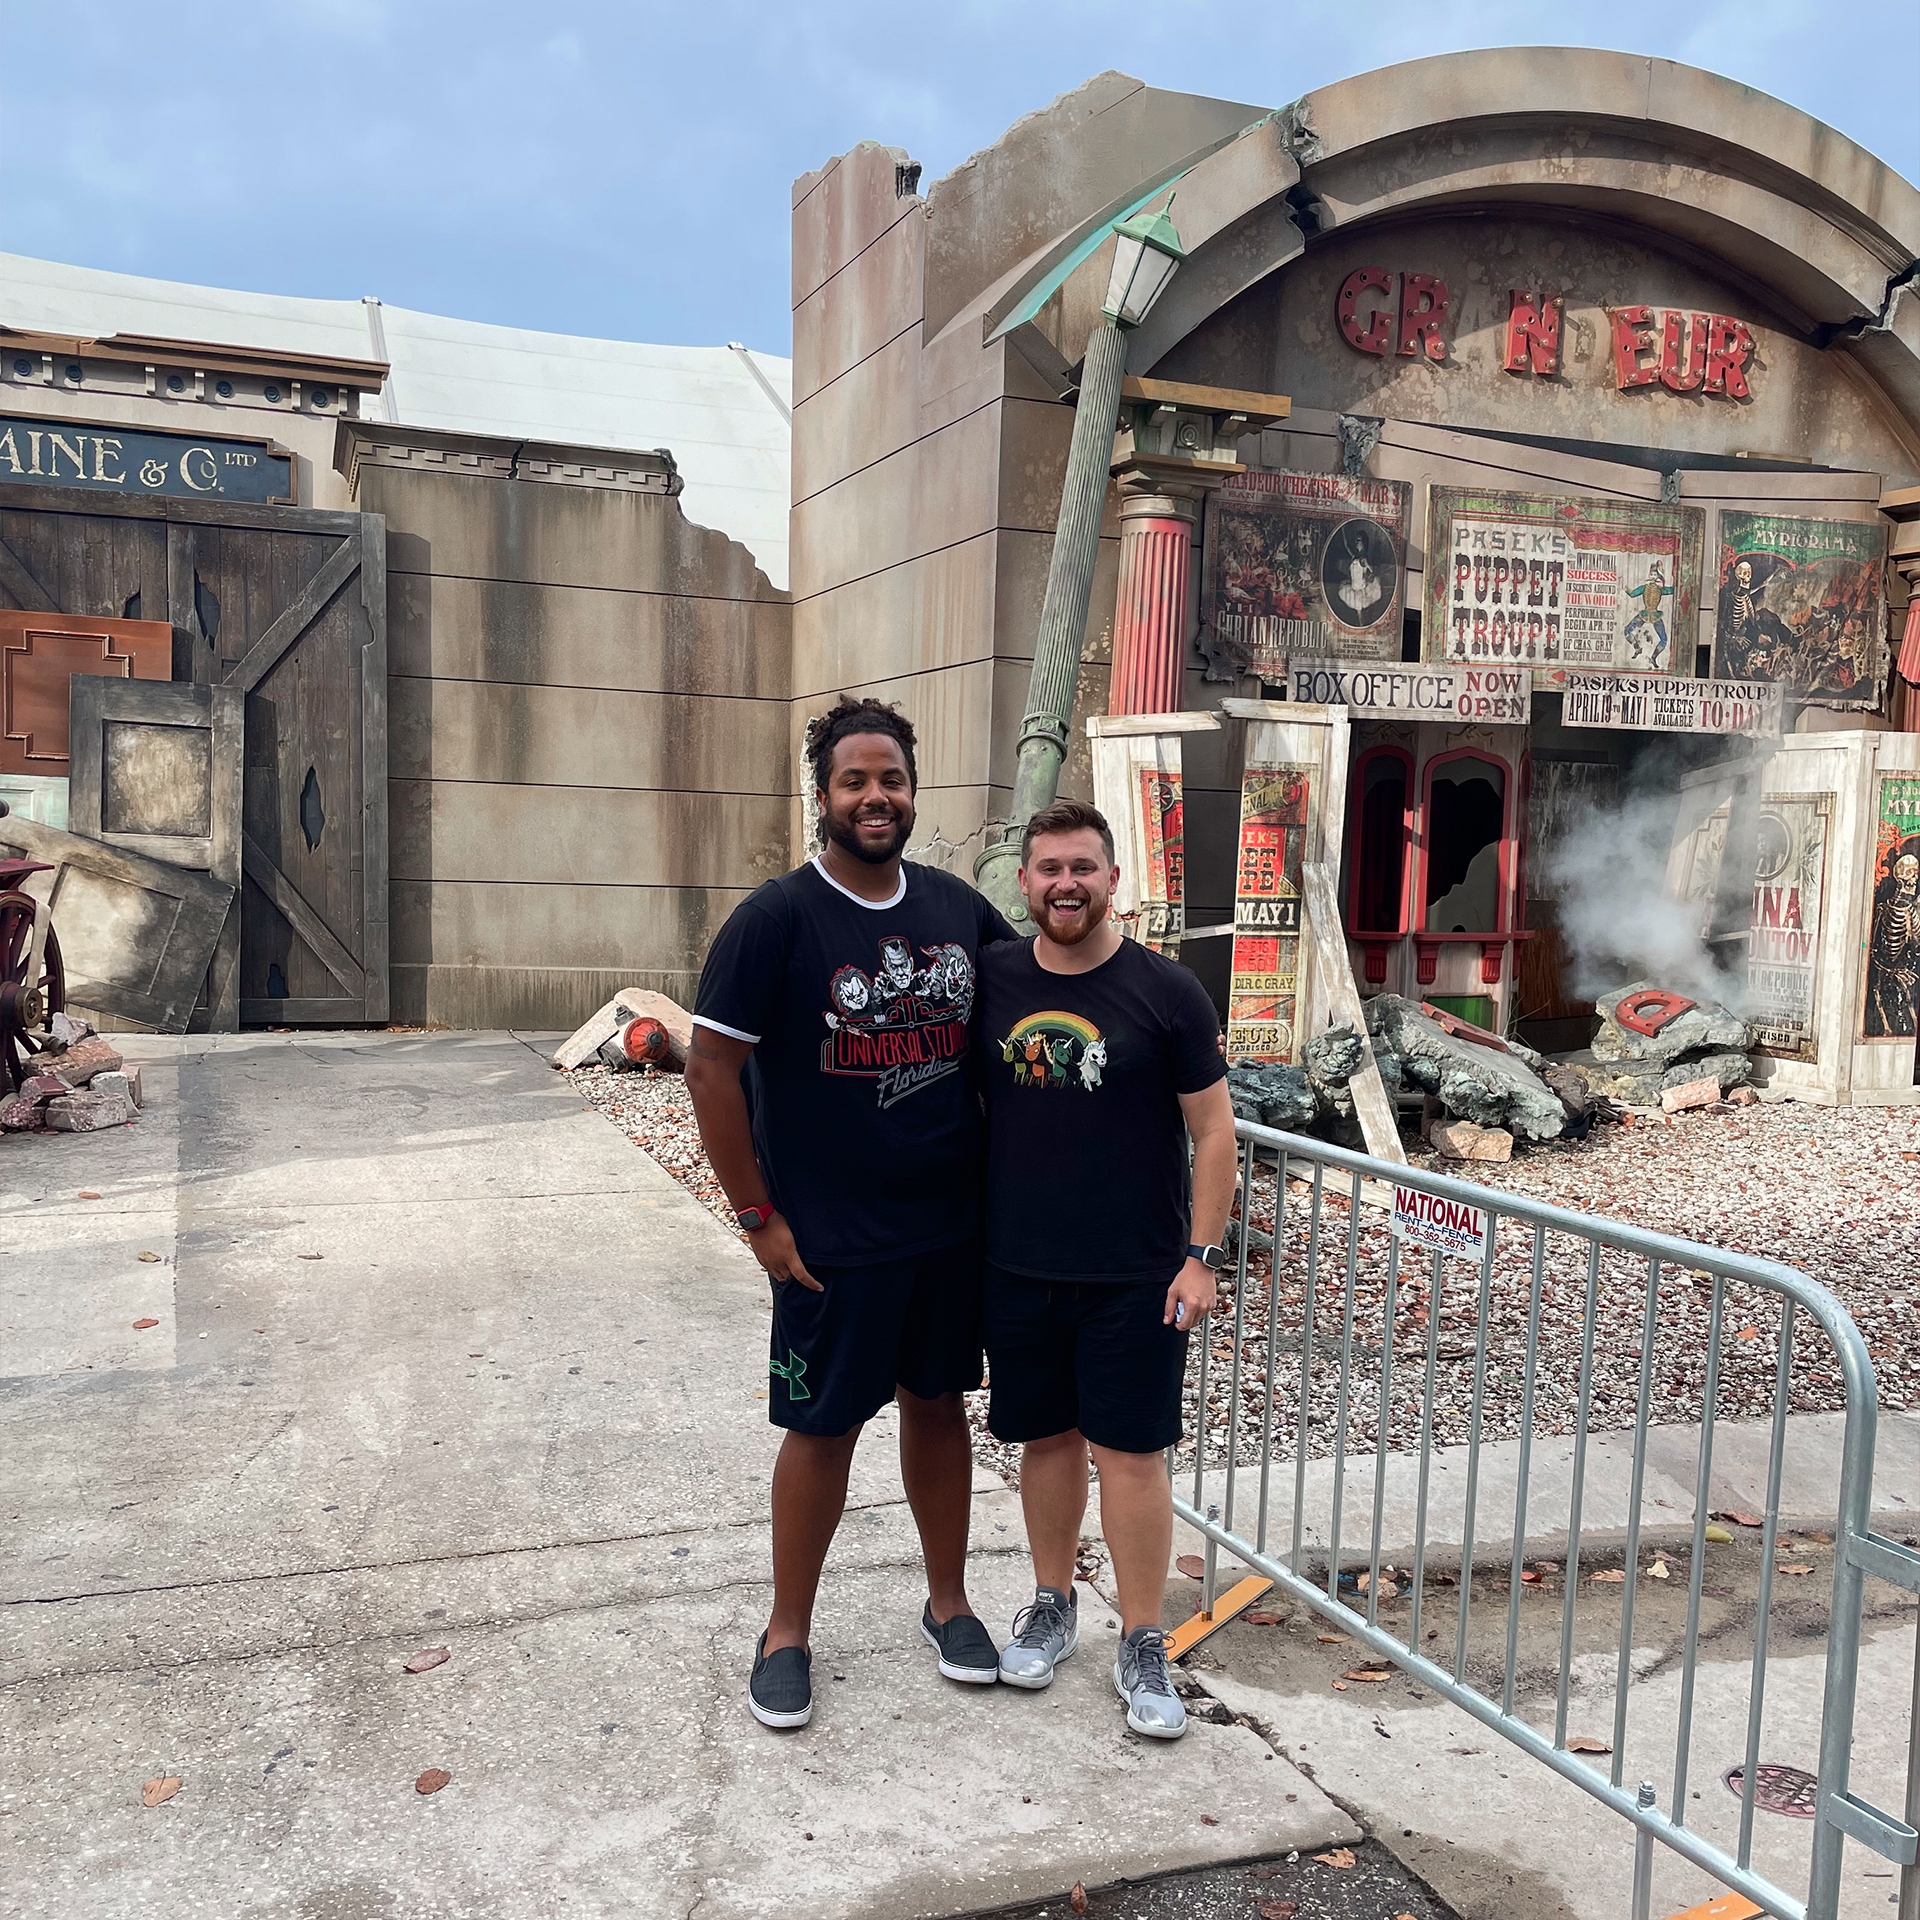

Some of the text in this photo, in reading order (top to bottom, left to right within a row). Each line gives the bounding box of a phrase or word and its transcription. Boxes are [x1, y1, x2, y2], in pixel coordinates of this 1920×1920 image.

[139, 459, 169, 488] &
[1228, 490, 1333, 508] SAN FRANCISCO
[1360, 482, 1390, 504] MAR
[1454, 527, 1566, 556] PASEK'S
[1753, 529, 1858, 553] MYRIORAMA
[1453, 553, 1565, 608] PUPPET
[1566, 570, 1617, 582] SUCCESS
[1565, 593, 1616, 607] THE WORLD
[1564, 607, 1615, 620] PERFORMANCES
[1564, 618, 1587, 630] BEGIN
[1268, 614, 1328, 650] REPUBLIC
[1452, 606, 1561, 660] TROUPE
[1595, 640, 1613, 652] GRAY
[1294, 671, 1454, 710] BOX OFFICE
[1465, 671, 1522, 694] NOW
[1568, 674, 1778, 701] PASEK'S PUPPET TROUPE
[1457, 693, 1526, 719] OPEN
[1567, 692, 1600, 723] APRIL
[1600, 694, 1612, 723] 19
[1620, 694, 1641, 725] MAY
[1653, 697, 1694, 714] TICKETS
[1652, 714, 1693, 728] AVAILABLE
[1240, 847, 1277, 869] ET
[1239, 869, 1275, 891] PE
[1236, 902, 1285, 926] MAY
[1264, 977, 1294, 990] GRAY
[1761, 970, 1809, 991] REPUBLIC
[1757, 1030, 1790, 1043] CISCO
[1790, 1020, 1804, 1032] 19
[838, 1027, 928, 1067] UNIVERSAL
[877, 1055, 959, 1108] Florida
[1395, 1186, 1483, 1237] NATIONAL
[1394, 1211, 1482, 1247] RENT-A-FENCE
[1404, 1224, 1466, 1252] 800-352-5675
